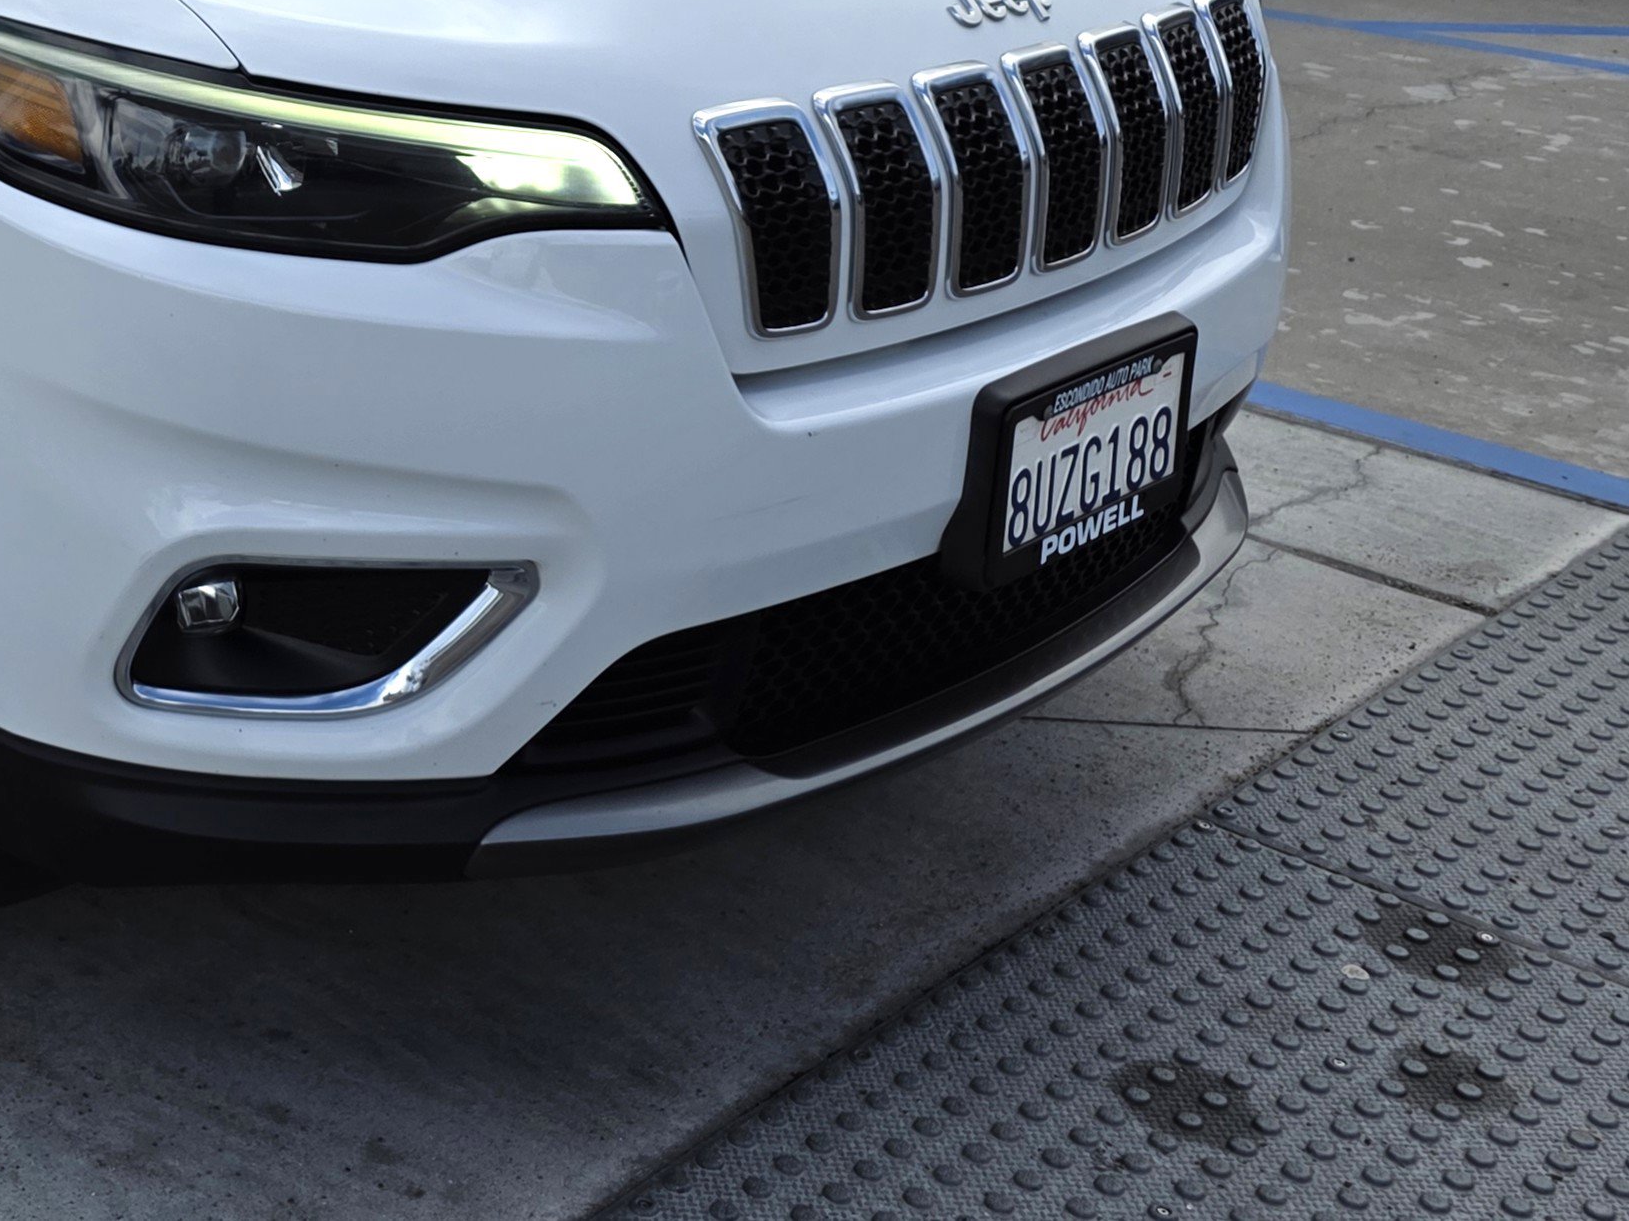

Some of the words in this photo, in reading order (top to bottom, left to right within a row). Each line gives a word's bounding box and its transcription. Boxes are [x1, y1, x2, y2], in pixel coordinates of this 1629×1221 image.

[1040, 377, 1154, 443] California
[1053, 375, 1105, 414] ESCONDIDO
[1103, 364, 1130, 393] AUTO
[1129, 355, 1156, 382] PARK
[1007, 405, 1173, 547] 8UZG188
[1039, 494, 1145, 565] POWELL
